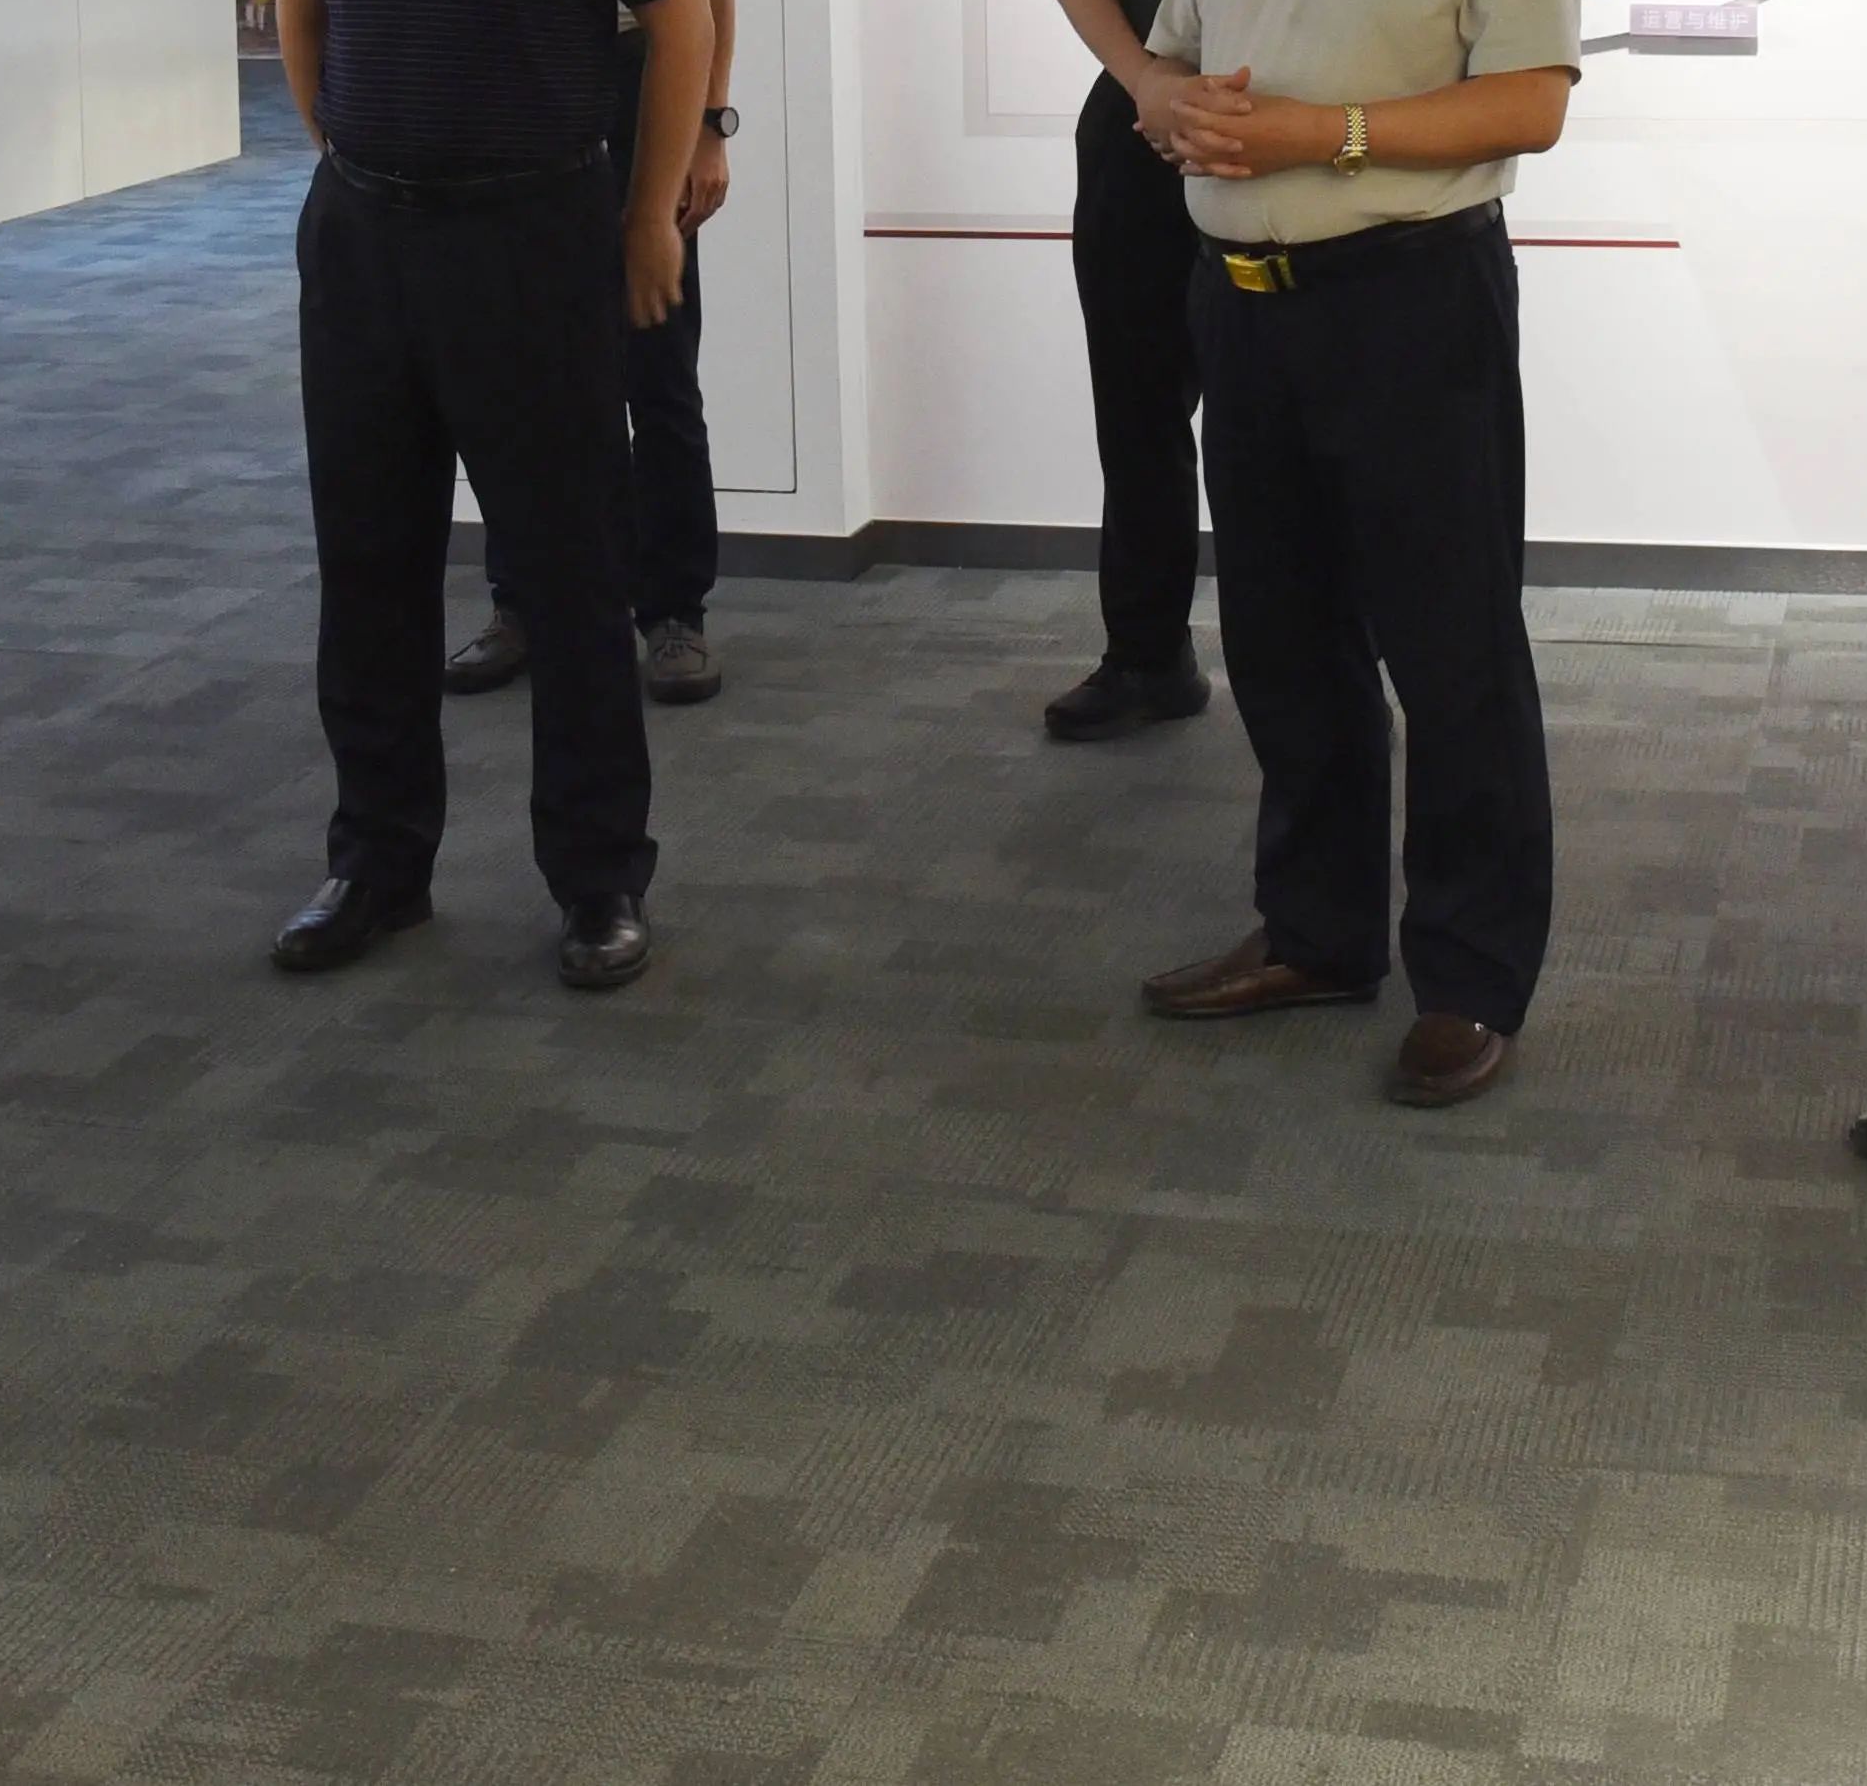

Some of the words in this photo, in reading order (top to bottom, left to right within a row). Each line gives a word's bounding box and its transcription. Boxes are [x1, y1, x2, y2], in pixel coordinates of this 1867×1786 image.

[1641, 10, 1749, 31] 运营与维护
